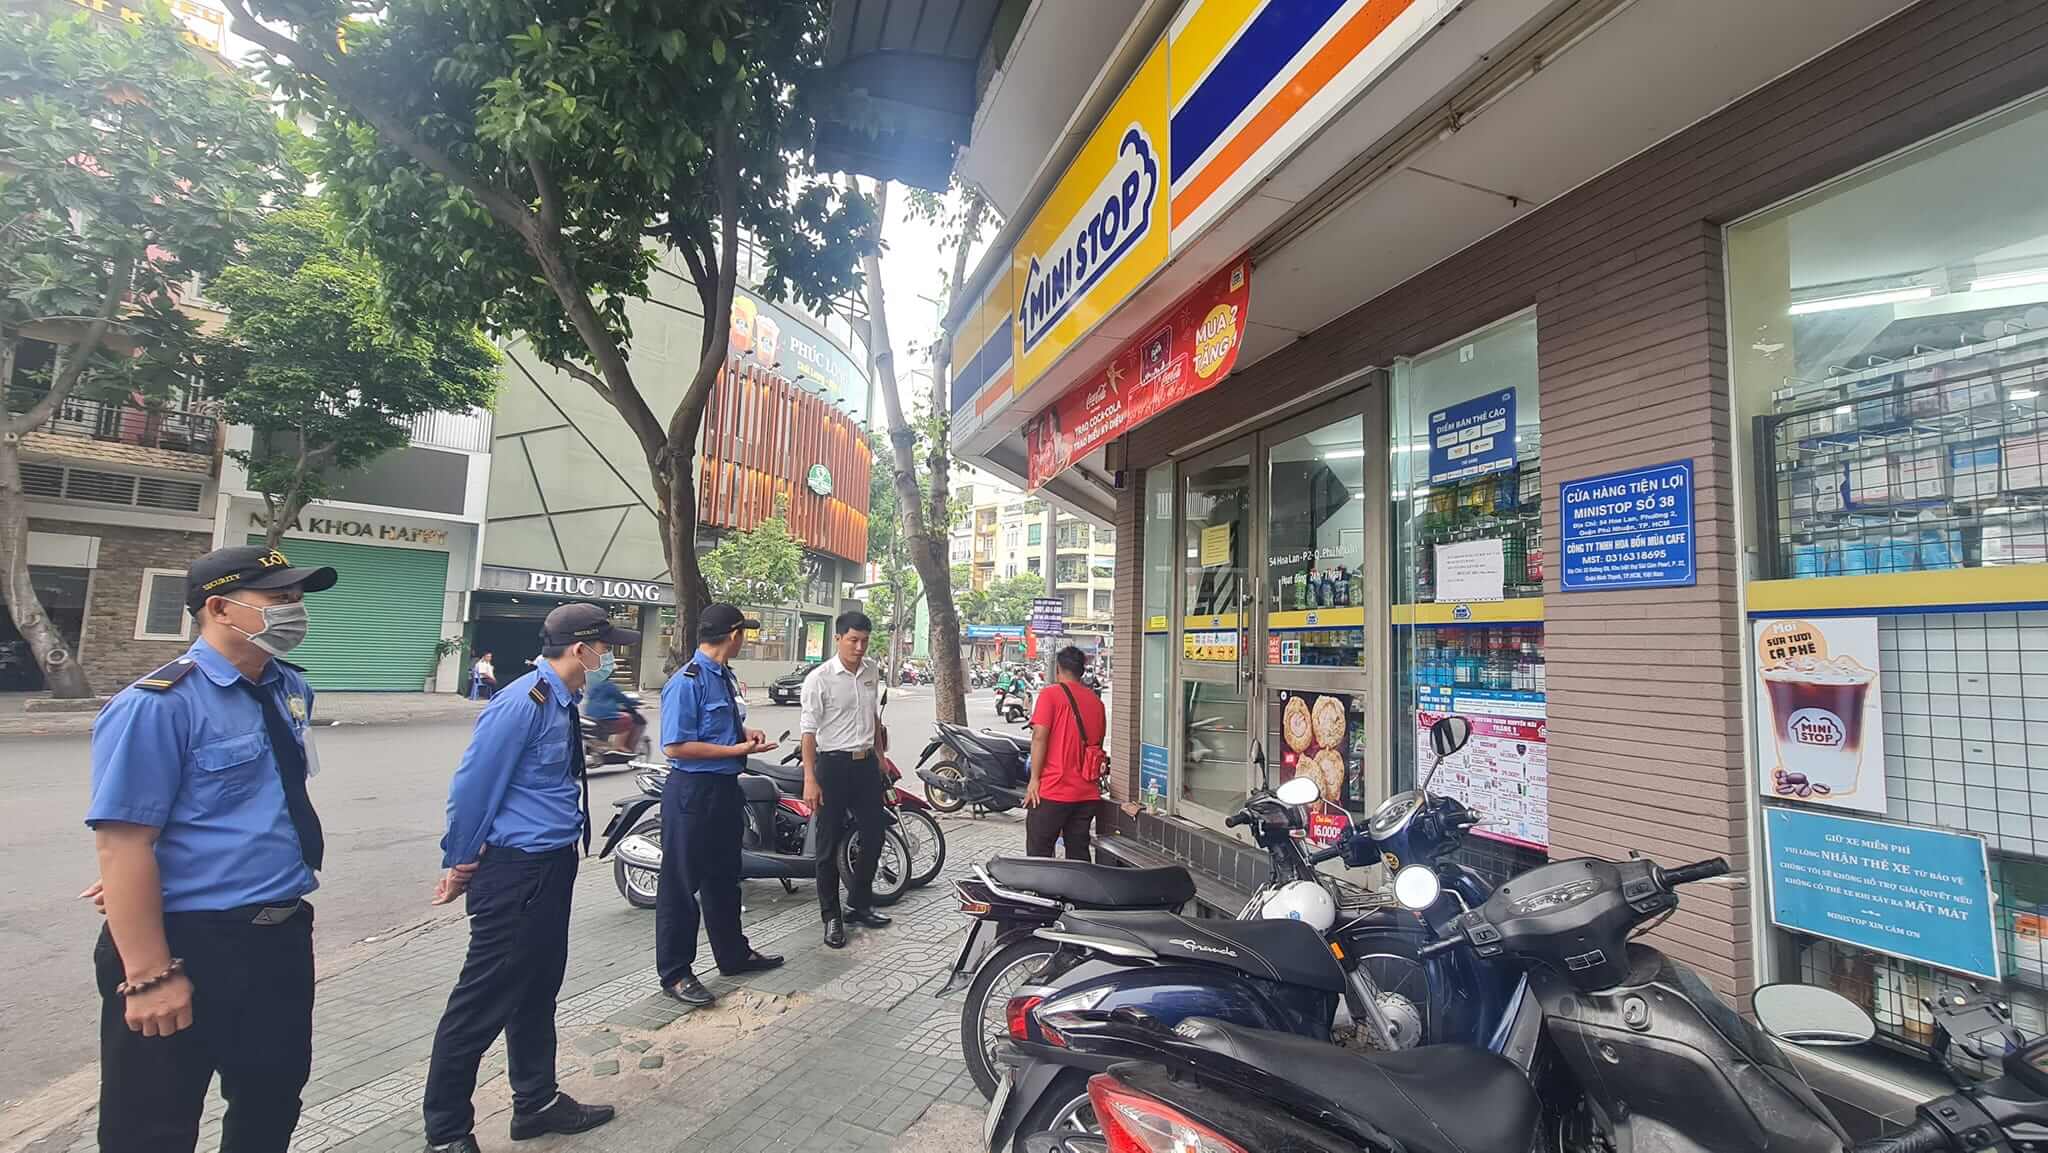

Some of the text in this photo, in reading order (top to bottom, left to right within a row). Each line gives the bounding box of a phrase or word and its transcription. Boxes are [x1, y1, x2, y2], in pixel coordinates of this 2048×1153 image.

[1030, 170, 1140, 331] MINI STOP
[1196, 305, 1238, 346] MUA 2
[1231, 331, 1237, 347] 1
[790, 336, 824, 369] PHÚC
[1090, 400, 1121, 428] COCA-COLA
[1488, 407, 1506, 419] CÀO
[1567, 474, 1683, 504] CỬA HÀNG TIỆN LỢI
[1574, 494, 1675, 519] MINISTOP SỐ 38
[250, 512, 448, 545] NA KHOA HAPPY
[1652, 519, 1670, 527] HCM
[1567, 541, 1584, 554] CÔNG
[1585, 542, 1594, 552] TY
[1615, 538, 1629, 549] HOA
[1647, 533, 1665, 546] MÙA
[1665, 532, 1686, 544] CAFE
[1582, 550, 1667, 564] MST: 0316318695
[202, 573, 241, 591] SECURITY
[527, 572, 661, 601] PHUC LONG
[1801, 722, 1832, 734] MINI
[1801, 732, 1833, 743] STOP
[1825, 833, 1912, 855] GIỮ XE MIỄN PHÍ
[1799, 847, 1820, 858] LÒNG
[1821, 850, 1858, 865] NHẬN
[1891, 862, 1911, 875] XE
[1833, 872, 1862, 884] KHÔNG
[1785, 876, 1812, 888] KHÔNG
[1844, 889, 1854, 898] XE
[1855, 891, 1870, 900] KHI
[1890, 898, 1903, 908] RA
[1826, 911, 1868, 926] MINISTOP
[1869, 920, 1884, 930] XIN
[1183, 938, 1239, 958] Grande
[1176, 1024, 1201, 1039] SYM
